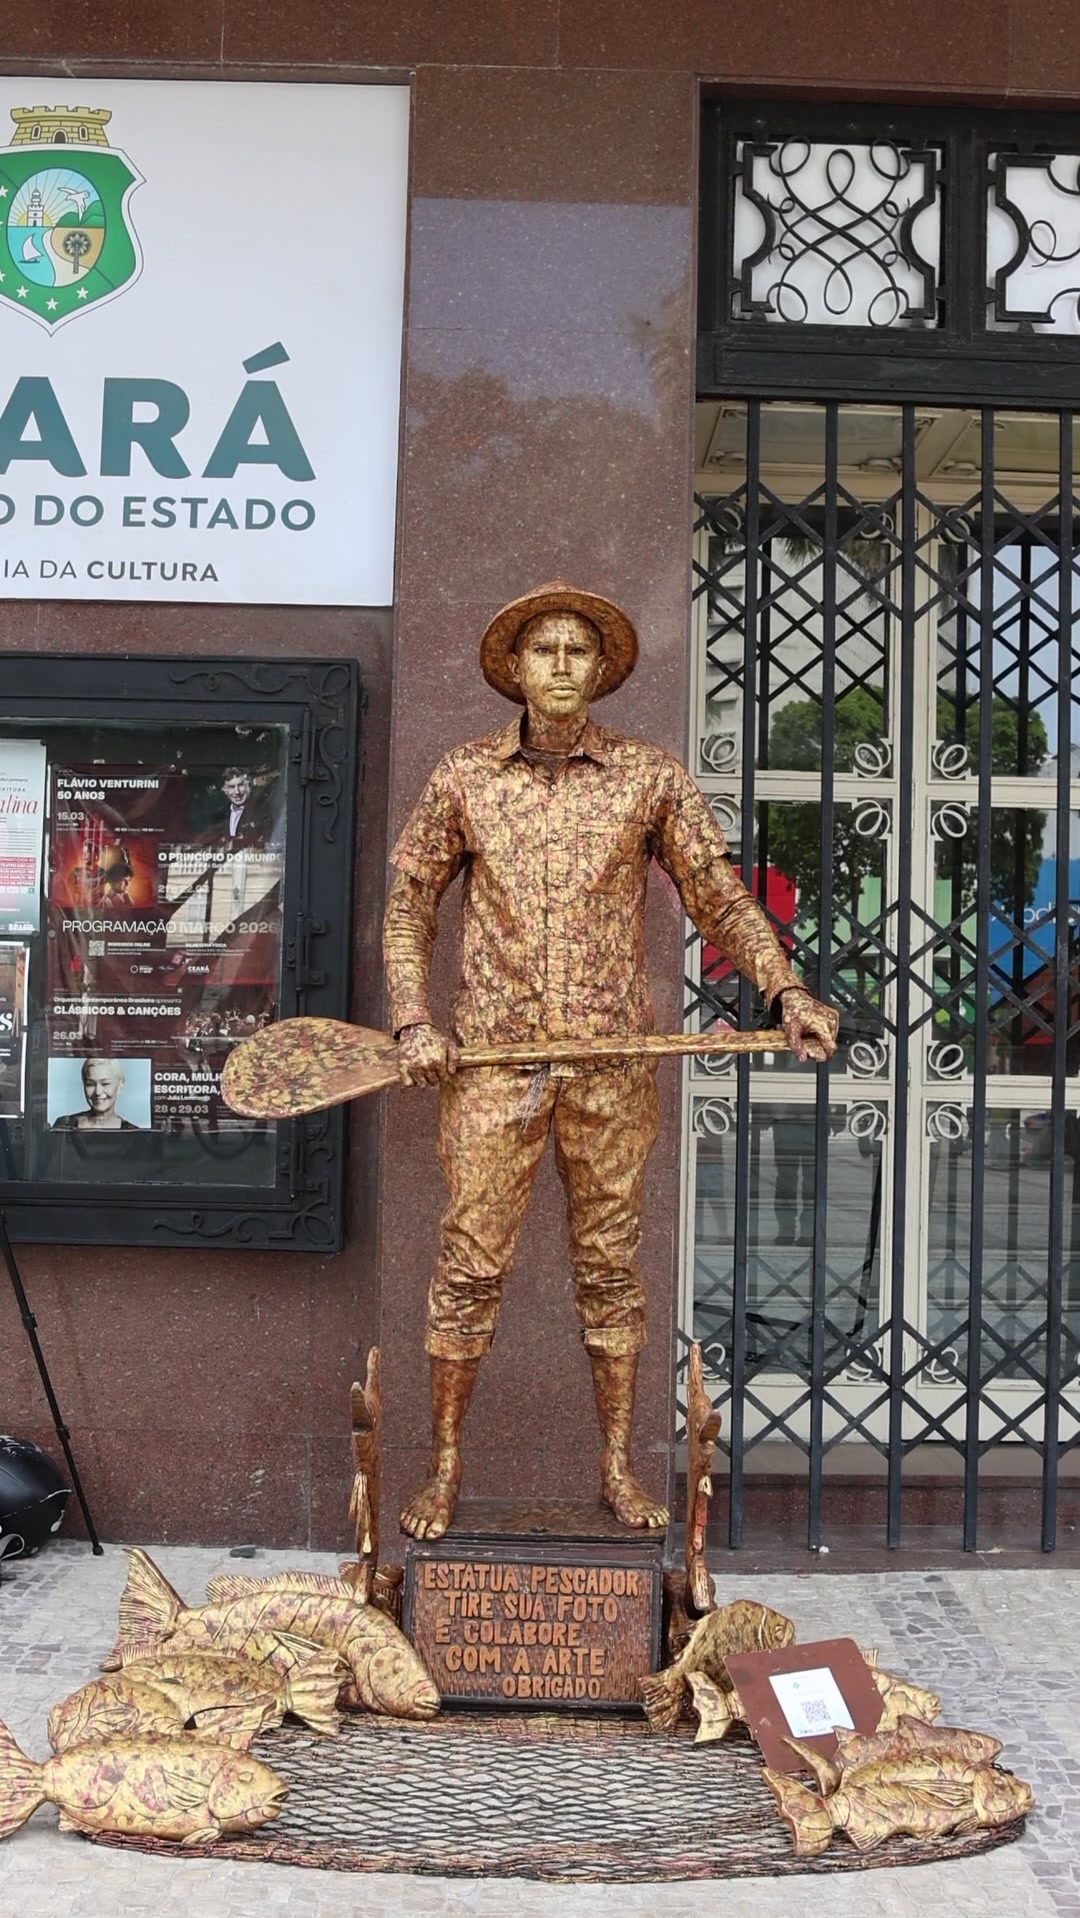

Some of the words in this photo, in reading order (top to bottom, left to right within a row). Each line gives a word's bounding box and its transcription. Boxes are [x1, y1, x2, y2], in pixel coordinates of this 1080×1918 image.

[34, 494, 104, 527] DO
[121, 496, 316, 532] ESTADO
[4, 559, 30, 579] IA
[40, 559, 77, 580] DA
[86, 560, 219, 583] CULTURA
[57, 777, 97, 788] FLÁVIO
[98, 779, 159, 788] VENTURINI
[57, 791, 72, 800] 50
[74, 791, 105, 800] ANOS
[57, 812, 85, 821] 15.03
[158, 852, 167, 862] O
[169, 851, 225, 862] PRINCÍPIO
[226, 853, 242, 862] DO
[62, 919, 177, 936] PROGRAMAÇÃO
[53, 1004, 115, 1016] CLÁSSICOS
[116, 1006, 126, 1016] &
[127, 1005, 182, 1018] CANÇÕES
[53, 1031, 83, 1040] 26.03
[154, 1072, 190, 1083] CORA,
[154, 1085, 221, 1096] ESCRITORA,
[154, 1104, 168, 1114] 28
[169, 1106, 177, 1114] e
[178, 1104, 209, 1114] 29.03
[424, 1563, 519, 1592] ESTATUA
[530, 1566, 639, 1596] PESCADOR
[504, 1594, 546, 1621] SUA
[557, 1596, 619, 1623] FOTO
[435, 1618, 452, 1644] E
[464, 1620, 581, 1647] COLABORE
[445, 1645, 501, 1674] COM
[512, 1647, 532, 1674] A
[542, 1648, 605, 1676] ARTE
